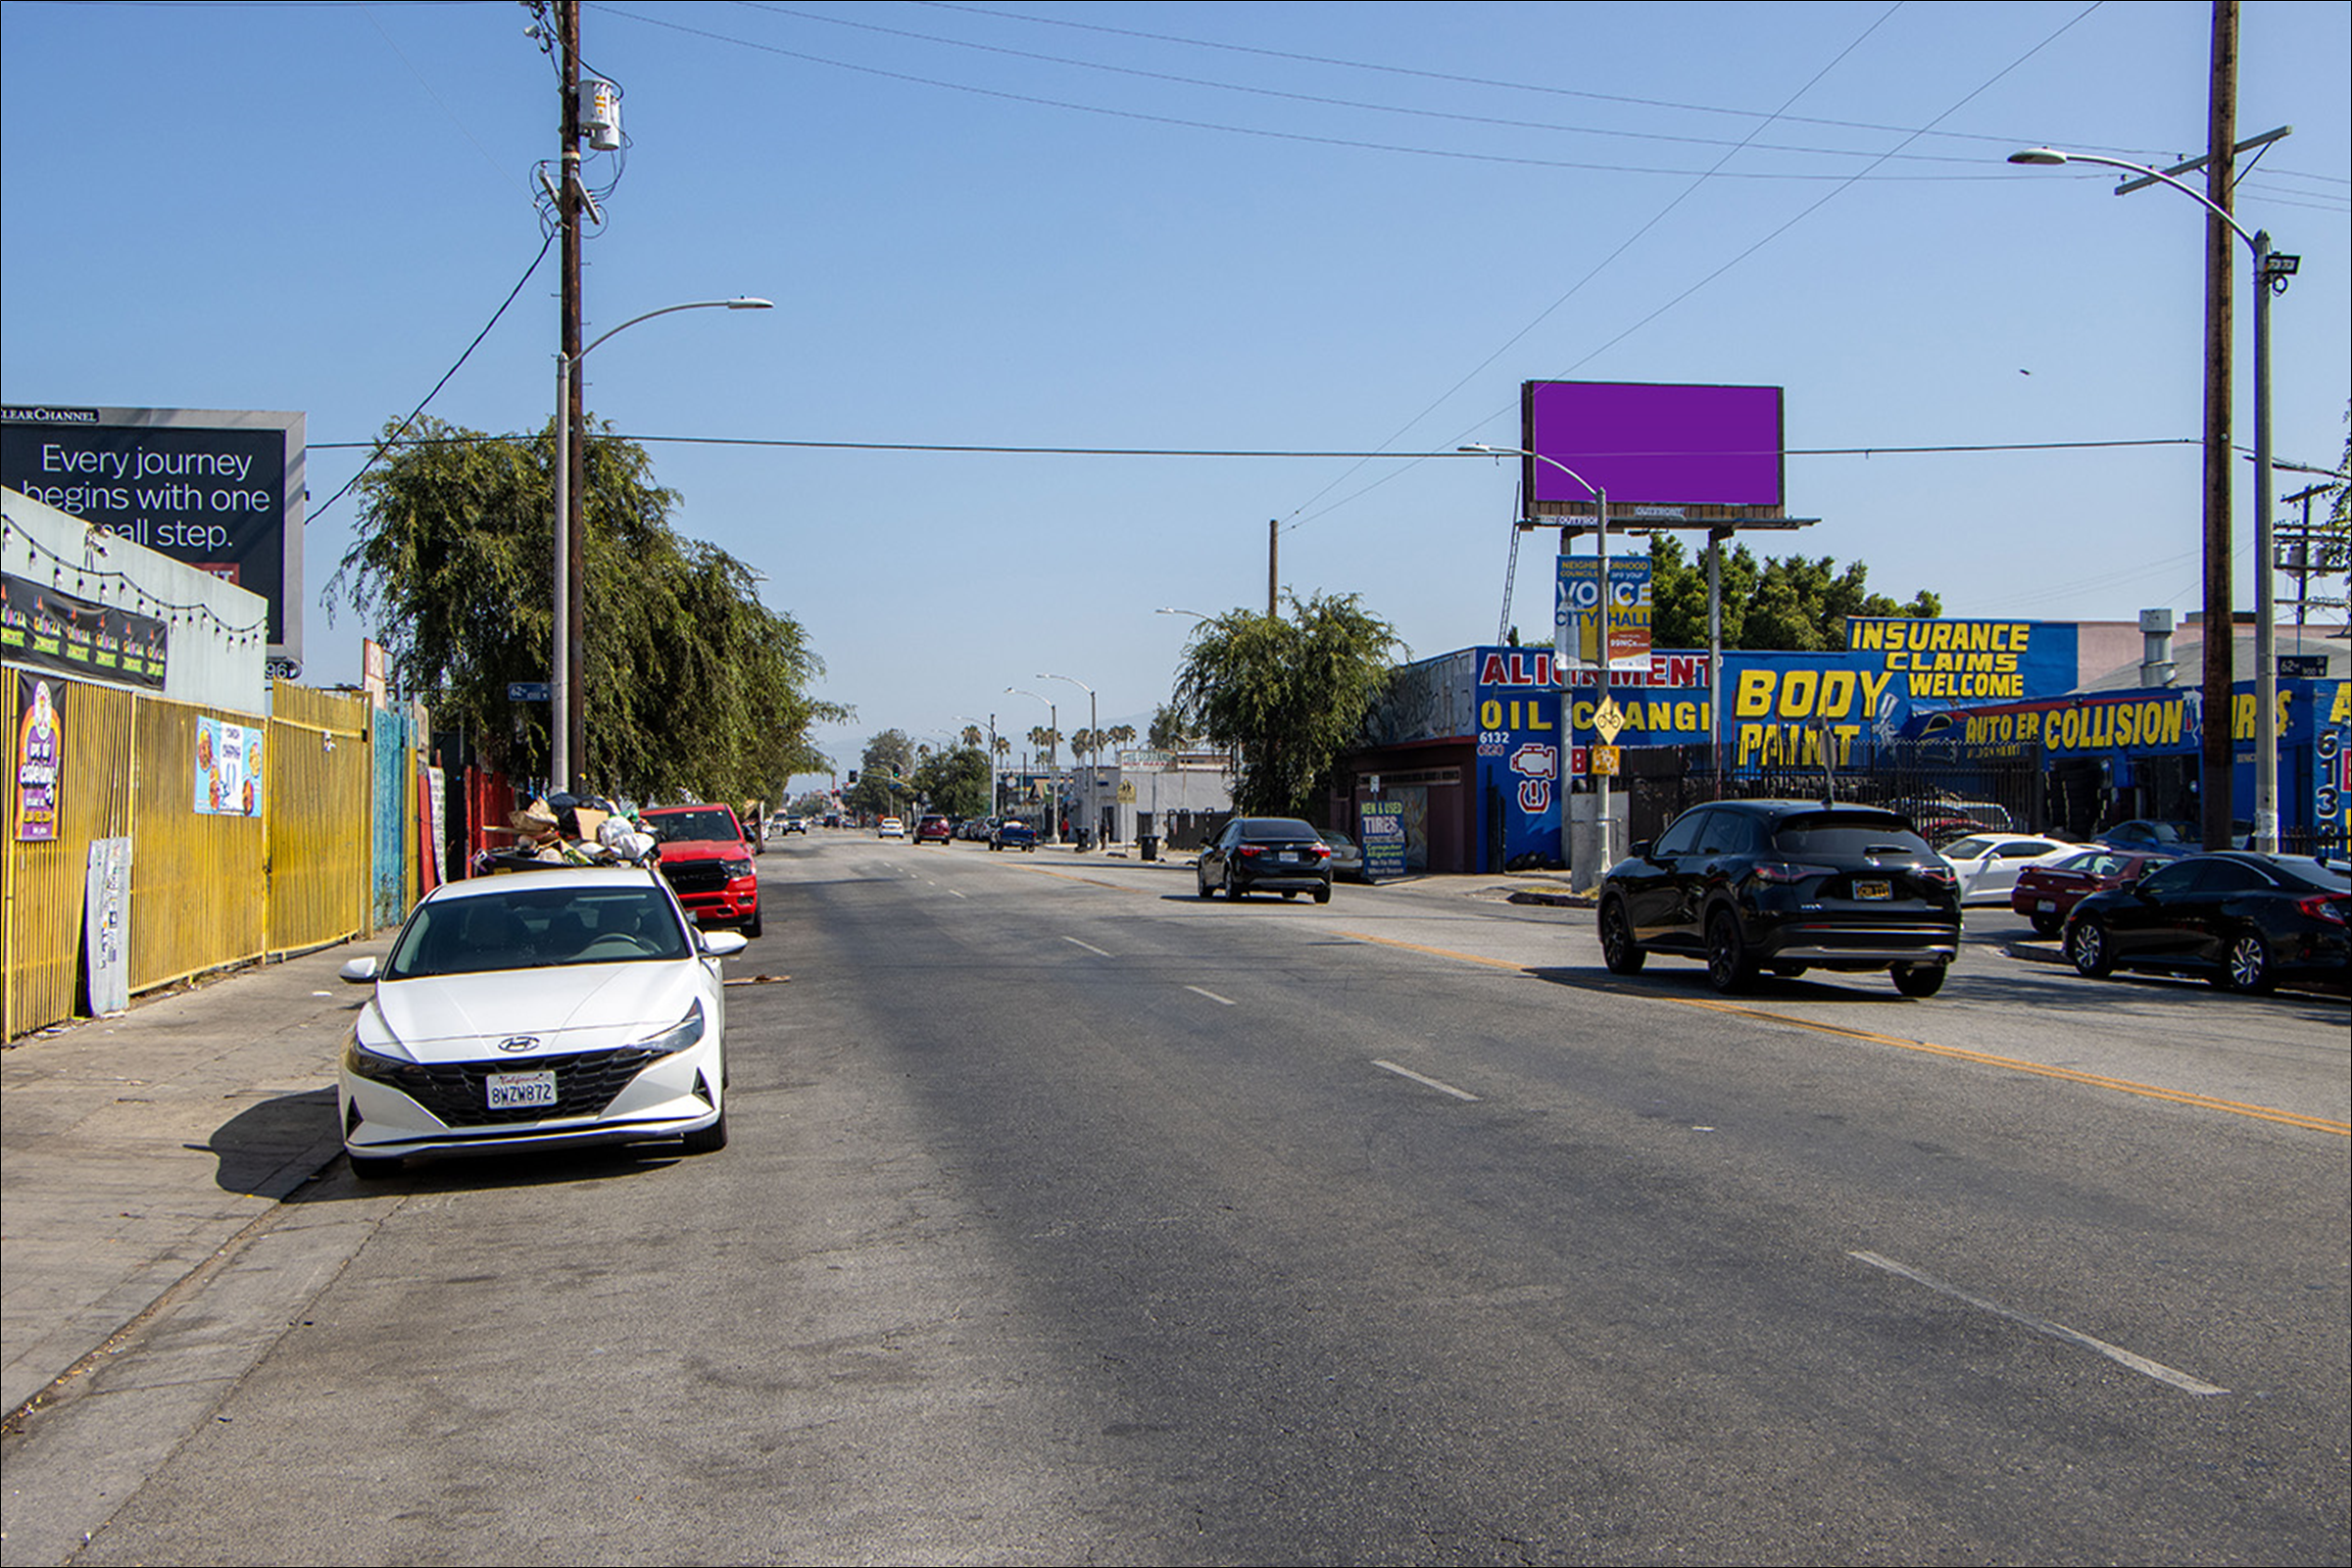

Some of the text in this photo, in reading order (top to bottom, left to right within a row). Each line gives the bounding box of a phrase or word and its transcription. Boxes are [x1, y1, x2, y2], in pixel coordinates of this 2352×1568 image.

[1, 408, 97, 422] LEARCHANNEL
[42, 444, 252, 481] Every journey
[23, 480, 270, 514] begins with one
[156, 520, 233, 552] step.
[1557, 581, 1651, 607] VOICE
[1555, 611, 1651, 627] CITY HALL
[1851, 621, 2030, 654] INSURANCE
[1885, 652, 2018, 674] CLAIMS
[1735, 669, 1893, 718] BODY
[1908, 672, 2024, 699] WELCOME
[1481, 700, 1710, 732] OIL CANG
[1966, 714, 2013, 744] AUTO
[2044, 700, 2184, 751] COLLISION
[1480, 731, 1509, 744] 6132
[1738, 724, 1861, 766] PAINT
[1361, 803, 1377, 814] NEW
[1385, 802, 1402, 814] USED
[1363, 815, 1398, 834] TIRES
